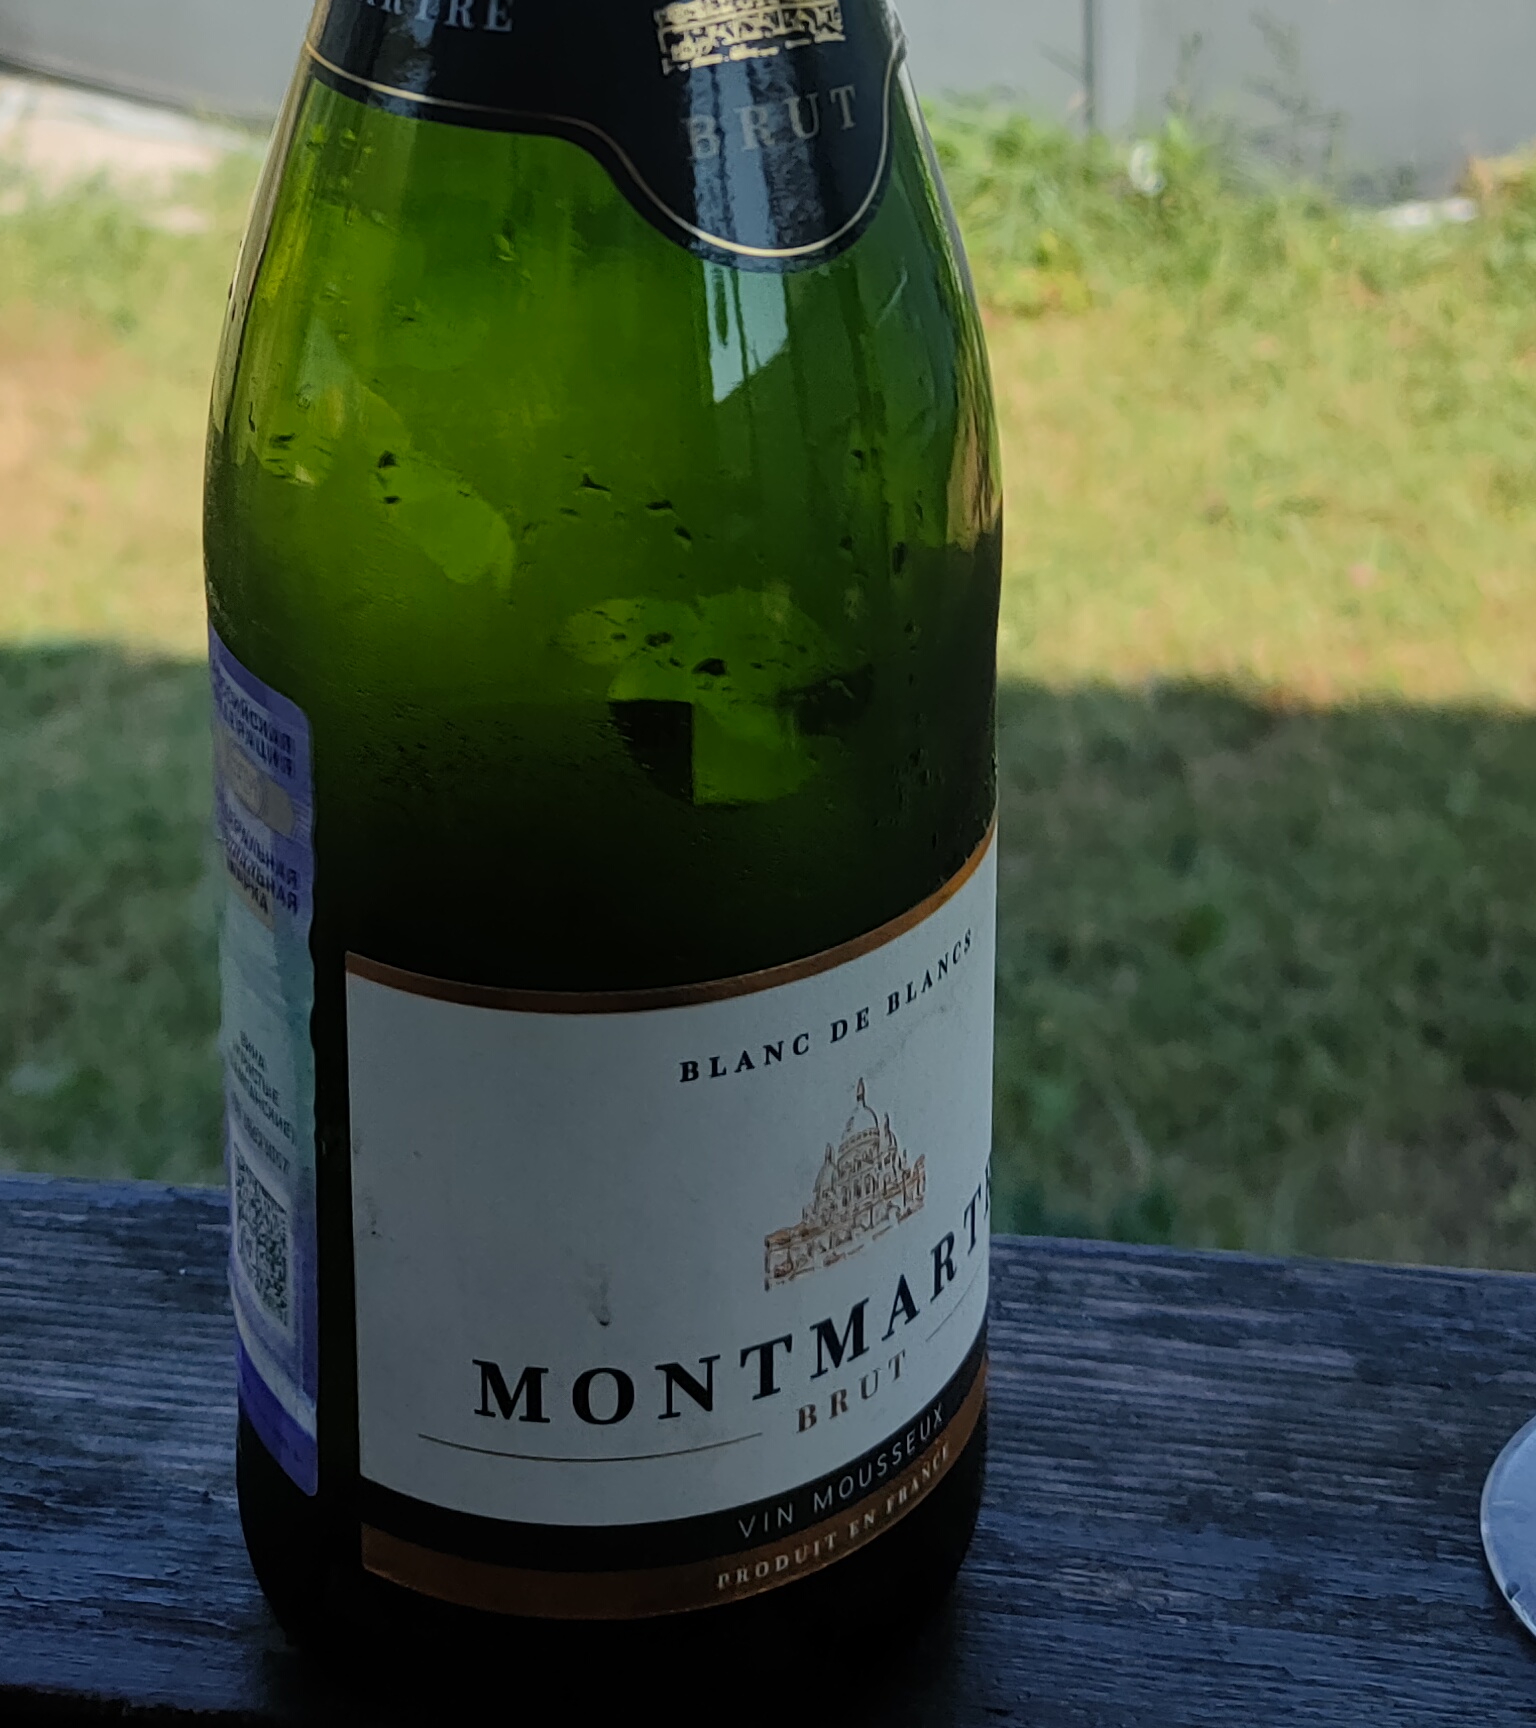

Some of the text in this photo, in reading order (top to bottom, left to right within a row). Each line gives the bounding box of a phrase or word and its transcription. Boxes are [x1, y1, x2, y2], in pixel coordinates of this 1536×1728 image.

[688, 84, 857, 160] BRUT
[678, 927, 973, 1083] BLANC DE BLANCS
[795, 1348, 908, 1434] BRUT
[716, 1442, 951, 1590] PRODUIT EN FRANCE
[737, 1402, 945, 1540] VIN MOUSSEUX
